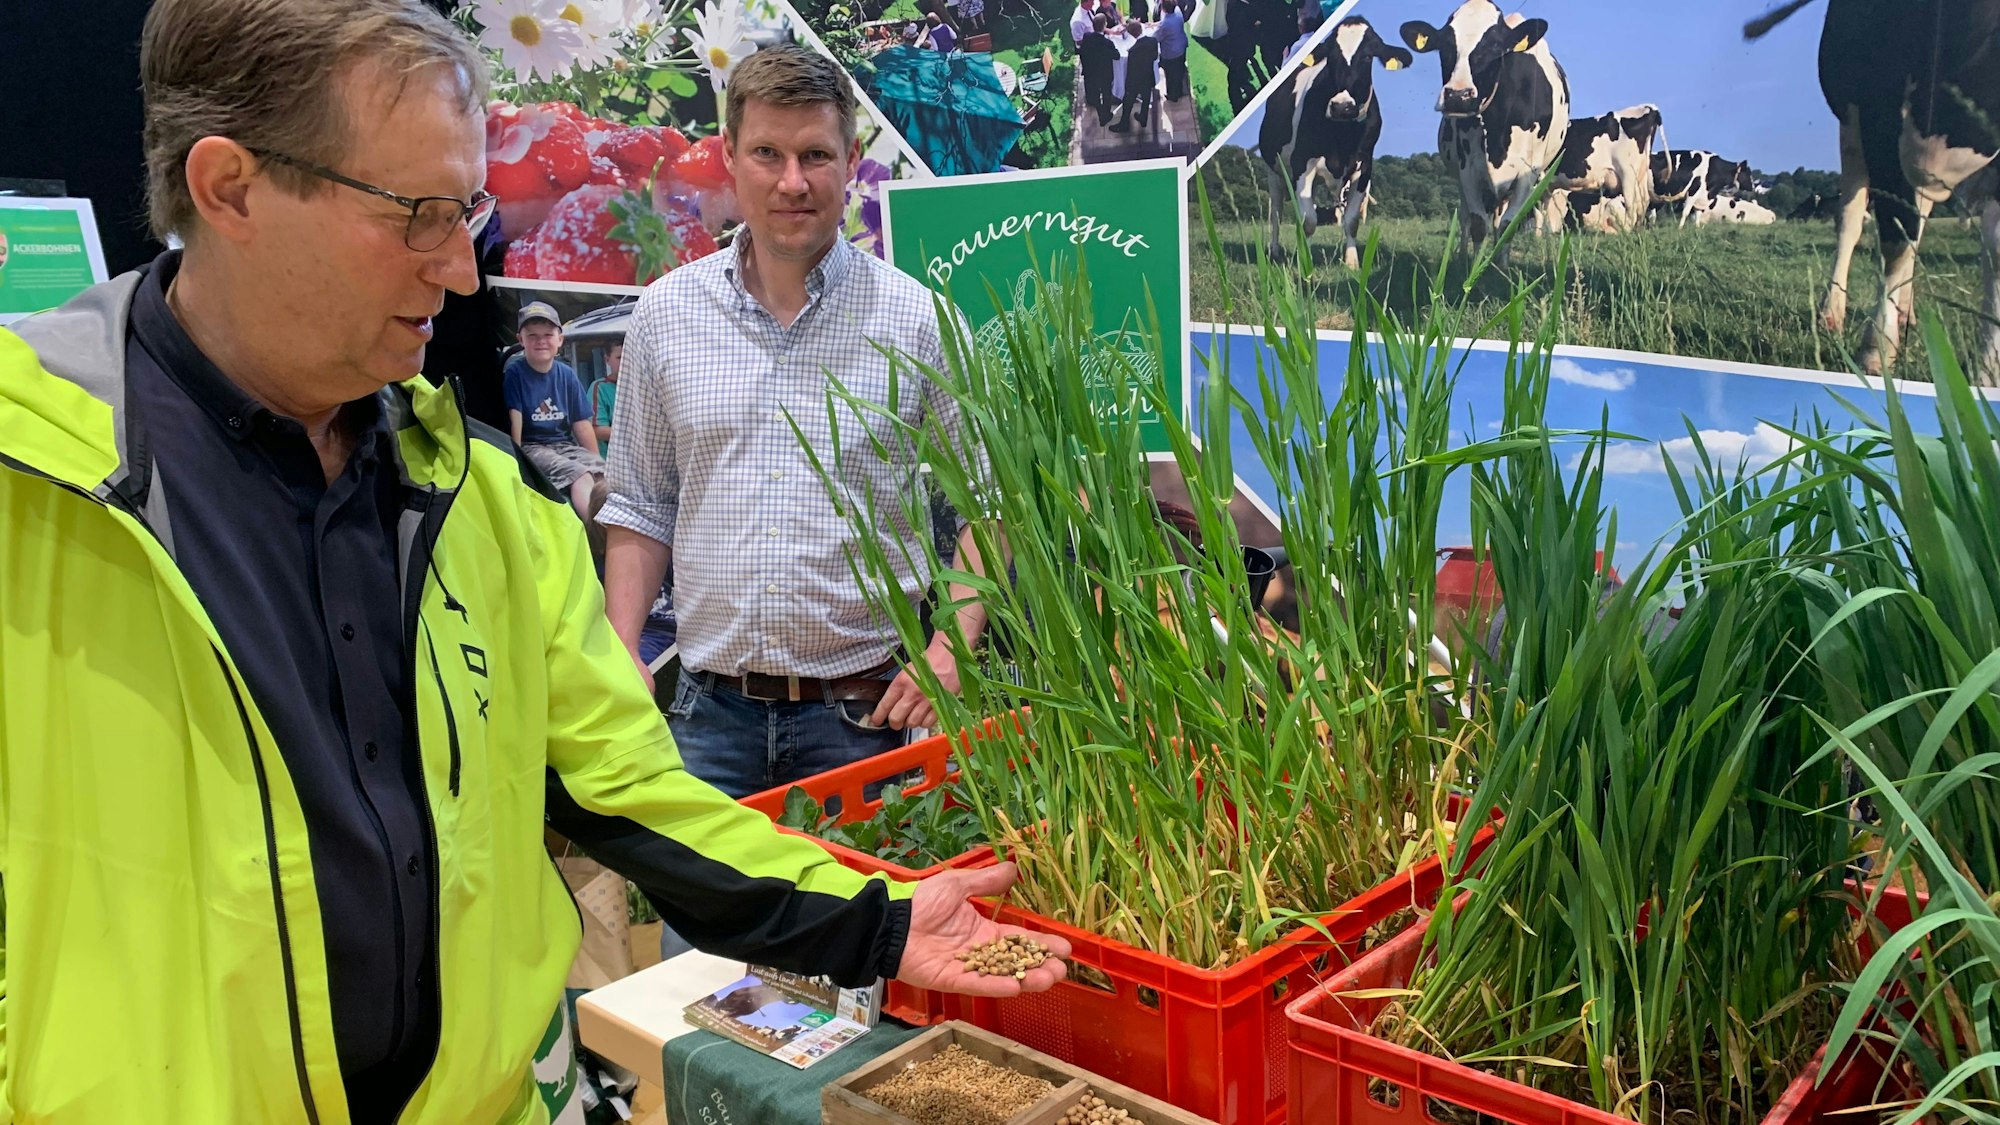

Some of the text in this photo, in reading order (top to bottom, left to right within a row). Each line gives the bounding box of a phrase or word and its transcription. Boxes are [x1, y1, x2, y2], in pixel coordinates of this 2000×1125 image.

[13, 243, 81, 253] ACKERBOHNEN
[928, 211, 1150, 286] Bauerngut
[531, 412, 564, 422] adidas
[750, 965, 764, 975] Lust
